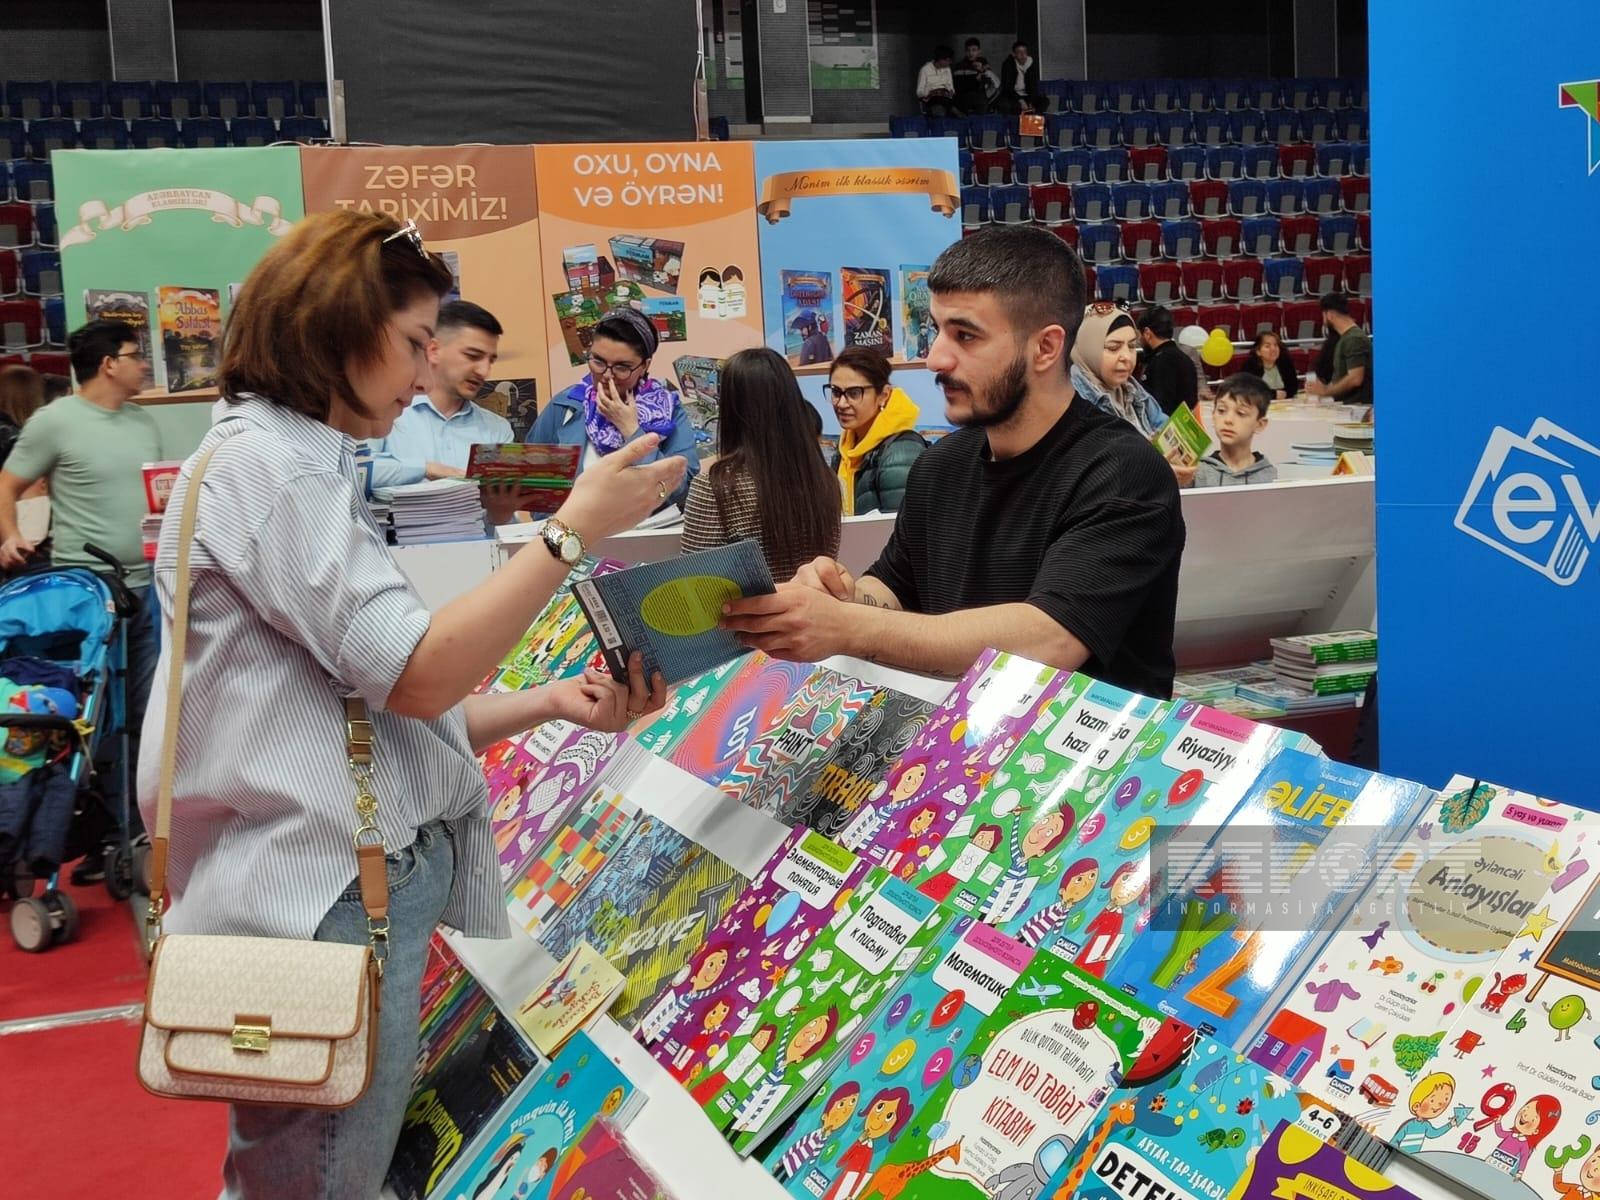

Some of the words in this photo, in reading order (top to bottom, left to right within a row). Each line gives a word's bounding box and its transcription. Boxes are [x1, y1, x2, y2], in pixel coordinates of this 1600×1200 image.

[363, 164, 477, 190] ZƏFƏR
[573, 153, 639, 178] OXU,
[645, 151, 722, 174] OYNA
[573, 185, 614, 208] VƏ
[620, 181, 724, 207] ÖYRƏN!
[784, 174, 831, 192] Mənim
[835, 175, 851, 187] ilk
[854, 330, 884, 340] ZAMAN
[774, 728, 816, 758] PAINT
[1505, 806, 1514, 816] 5
[786, 847, 844, 889] Элементарные
[786, 871, 821, 897] понятия
[859, 904, 908, 946] Подготовка
[856, 931, 889, 962] письму
[891, 1000, 904, 1017] 2
[856, 1039, 872, 1056] 5
[929, 1057, 944, 1073] 2
[987, 1048, 1024, 1081] ELM
[1015, 1060, 1040, 1092] VƏ
[1033, 1072, 1086, 1126] TƏBİƏT
[981, 1095, 1037, 1148] KİTABIM
[1308, 1109, 1335, 1130] 4-6
